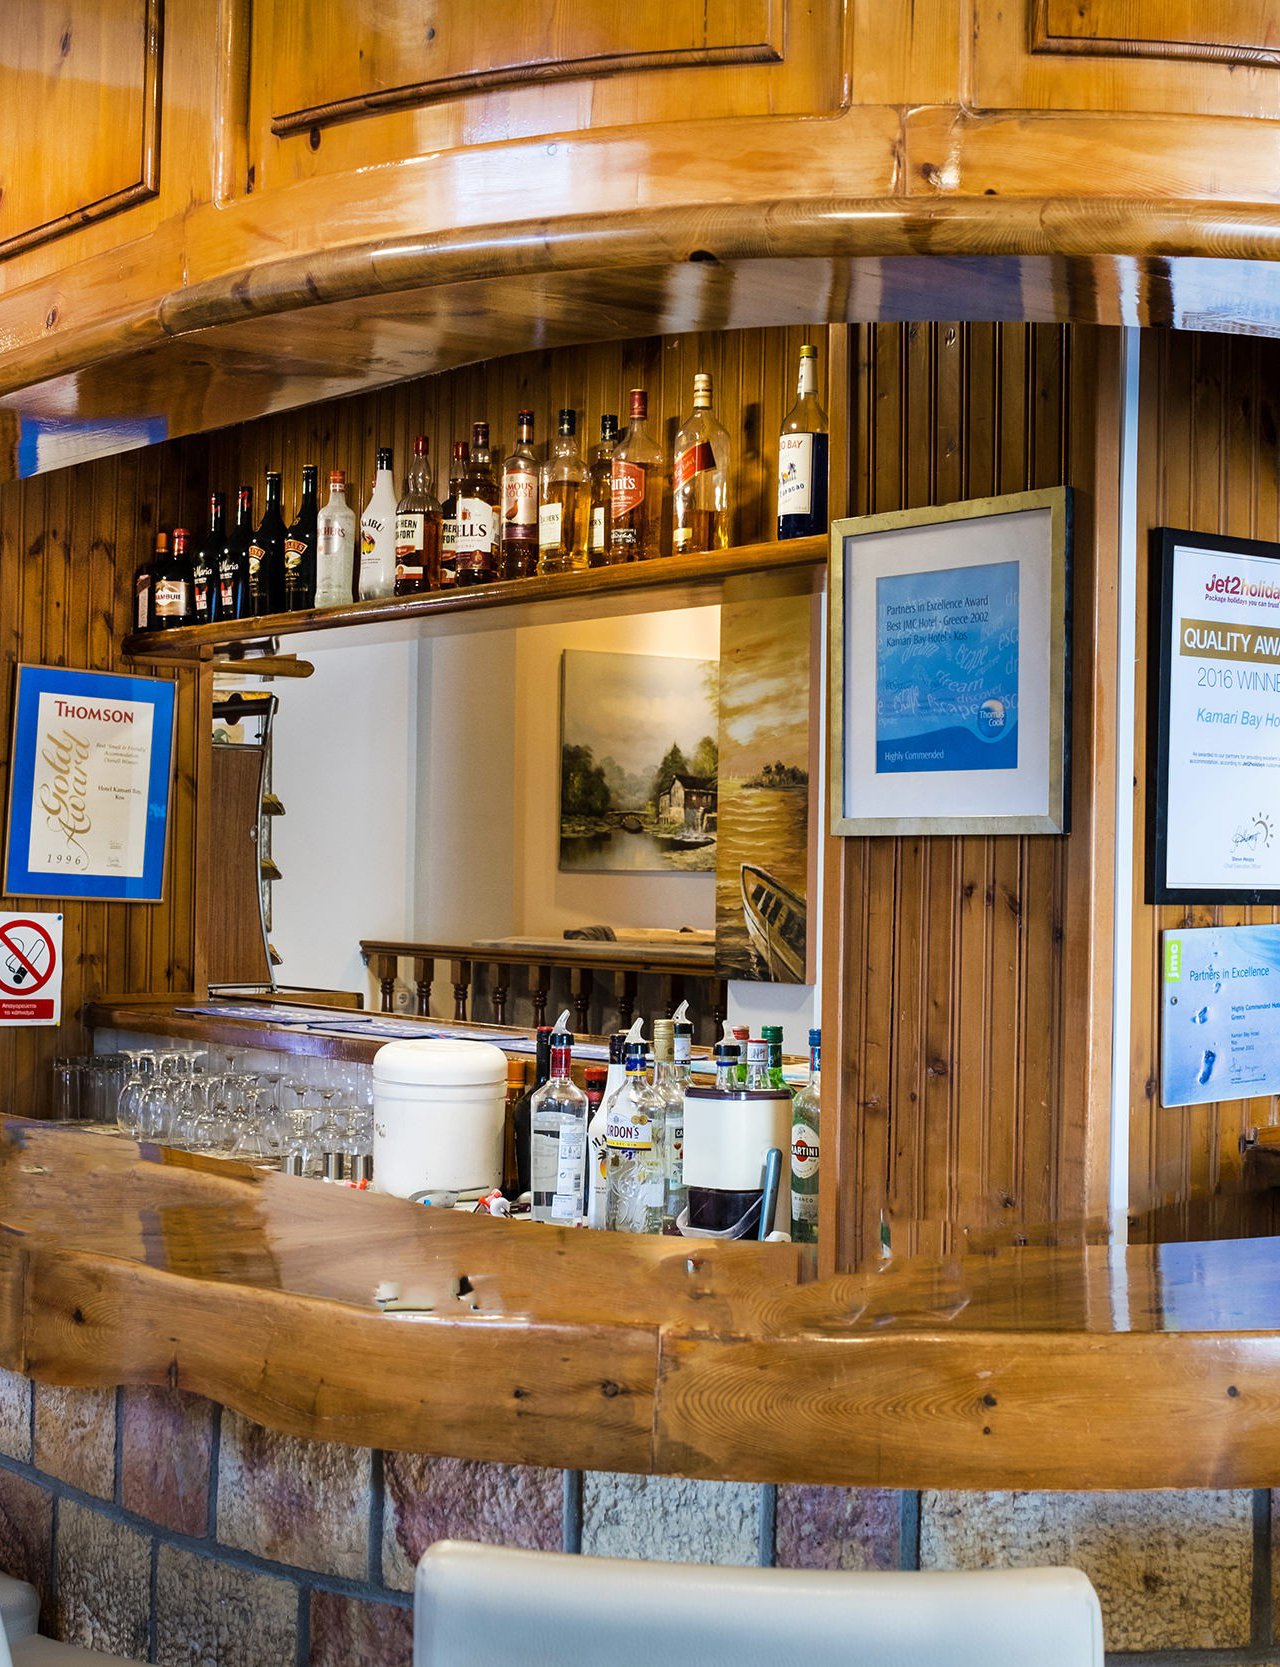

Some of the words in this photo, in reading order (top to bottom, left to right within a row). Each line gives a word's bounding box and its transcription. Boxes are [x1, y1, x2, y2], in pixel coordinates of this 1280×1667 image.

[787, 439, 803, 449] BAY
[886, 604, 916, 616] Partners
[926, 599, 963, 612] Excellence
[964, 594, 990, 608] Award
[1205, 594, 1227, 604] Package
[1248, 599, 1258, 608] you
[886, 620, 901, 632] Best
[919, 616, 938, 629] Hotel
[943, 614, 969, 626] Greece
[969, 611, 990, 625] 2002
[886, 635, 912, 647] Kamari
[913, 634, 928, 647] Bay
[928, 631, 948, 643] Hotel
[953, 630, 969, 642] Kos
[1184, 627, 1252, 653] QUALITY
[935, 669, 984, 693] dream
[1197, 667, 1234, 689] 2016
[979, 710, 1005, 720] Thomas
[988, 718, 1005, 728] Cook
[1196, 707, 1239, 725] Kamari
[1240, 710, 1263, 730] Bay
[884, 751, 904, 764] Highly
[904, 749, 945, 761] Commended
[38, 730, 74, 822] Gold
[47, 729, 92, 871] Award
[47, 853, 82, 866] 1996
[1189, 968, 1220, 982] Partners
[1222, 967, 1230, 980] in
[1231, 965, 1271, 980] Excellence
